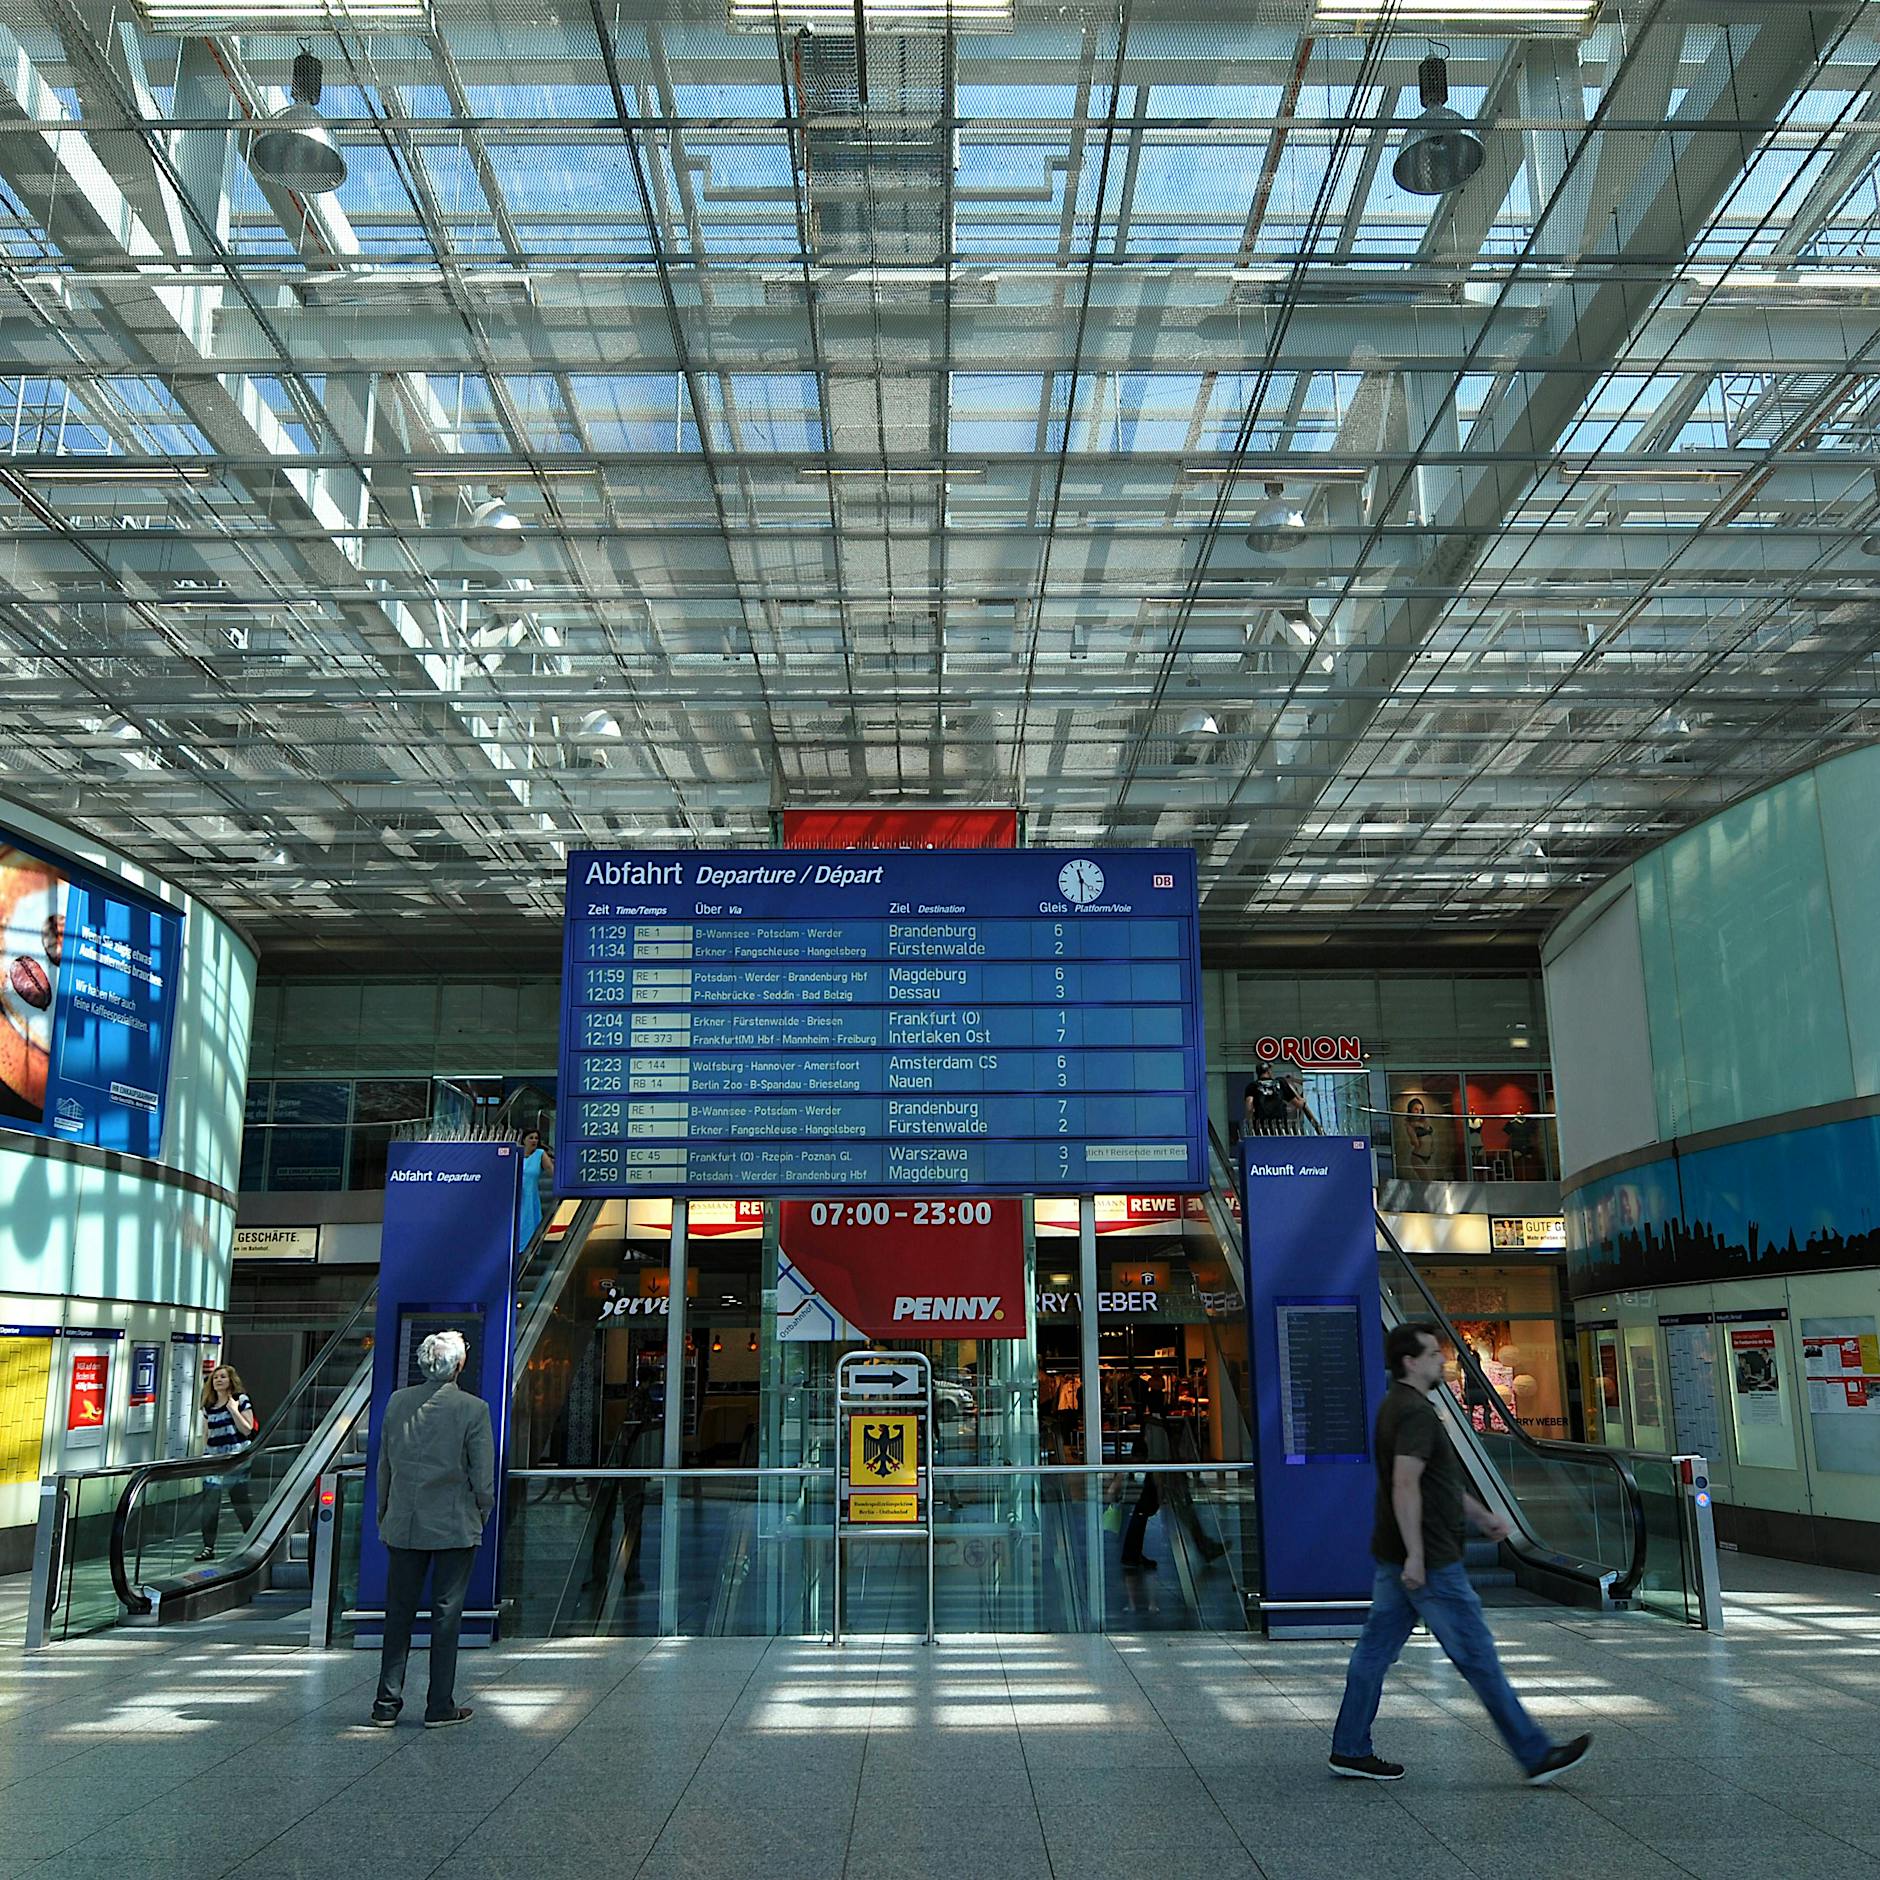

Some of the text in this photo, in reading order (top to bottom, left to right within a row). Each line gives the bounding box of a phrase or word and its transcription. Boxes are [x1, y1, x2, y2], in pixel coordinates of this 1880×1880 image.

[586, 861, 883, 887] Abfahrt Departure Départ
[1154, 876, 1172, 887] DB
[588, 904, 667, 915] Zeit Time/Temps
[696, 902, 742, 914] Über Via
[889, 902, 965, 913] Ziel Destination
[1039, 902, 1131, 913] Gleis Platform/Voie
[589, 927, 626, 939] 11:29
[638, 928, 660, 937] RE 1
[696, 929, 842, 939] B-Wannsee Potsdam Werder
[889, 924, 976, 939] Brandenburg
[1054, 924, 1063, 936] 6
[588, 944, 625, 957] 11:34
[638, 946, 660, 955] RE 1
[695, 947, 866, 958] Erkner Fangschleuse Hangelsberg
[889, 941, 985, 955] Fürstenwalde
[1055, 942, 1063, 954] 2
[587, 970, 624, 983] 11:59
[636, 972, 659, 981] RE 1
[694, 972, 867, 983] Potsdam Werder Brandenburg Hbf
[889, 969, 966, 984] Magdeburg
[1055, 968, 1064, 981] 6
[587, 988, 624, 1001] 12:03
[636, 990, 658, 999] RE 7
[694, 990, 852, 1001] P-Rehbrücke Seddin Bad Belzig
[889, 987, 940, 999] Dessau
[1056, 986, 1064, 998] 3
[586, 1014, 623, 1027] 12:04
[636, 1016, 657, 1025] RE 1
[694, 1016, 843, 1026] Erkner Fürstenwalde Briesen
[889, 1011, 980, 1025] Frankfurt (O)
[1060, 1012, 1065, 1024] 1
[585, 1032, 622, 1045] 12:19
[634, 1034, 672, 1043] ICE 373
[693, 1035, 876, 1046] Frankfurt(M) Hbf Mannheim Freiburg
[889, 1030, 990, 1043] Interlaken Ost
[1057, 1030, 1065, 1042] 7
[1256, 1036, 1363, 1068] ORION
[584, 1059, 622, 1071] 12:23
[633, 1060, 665, 1069] IC 144
[693, 1061, 859, 1072] Wolfsburg Hannover Amersfoort
[889, 1056, 997, 1069] Amsterdam CS
[1057, 1056, 1066, 1068] 6
[583, 1077, 621, 1090] 12:26
[633, 1079, 662, 1088] RB 14
[692, 1079, 860, 1090] Berlin Zoo B-Spandau Brieselang
[889, 1075, 932, 1088] Nauen
[1058, 1075, 1066, 1086] 3
[582, 1103, 620, 1117] 12:29
[632, 1105, 654, 1114] RE 1
[691, 1106, 841, 1116] B-Wannsee Potsdam Werder
[889, 1101, 978, 1117] Brandenburg
[1059, 1101, 1067, 1113] 7
[581, 1122, 619, 1136] 12:34
[632, 1124, 654, 1133] RE 1
[691, 1124, 866, 1135] Erkner Fangschleuse Hangelsberg
[889, 1119, 987, 1133] Fürstenwalde
[1059, 1120, 1068, 1132] 2
[581, 1149, 618, 1163] 12:50
[631, 1151, 660, 1161] EC 45
[690, 1152, 736, 1162] Frankfurt
[762, 1152, 793, 1163] Rzepin
[802, 1152, 836, 1161] Poznan
[890, 1147, 967, 1160] Warszawa
[1060, 1147, 1068, 1159] 3
[579, 1168, 618, 1181] 12:59
[630, 1170, 653, 1179] RE 1
[690, 1170, 867, 1181] Potsdam Werder Brandenburg Hbf
[889, 1166, 968, 1182] Magdeburg
[1060, 1165, 1069, 1177] 7
[1251, 1165, 1328, 1175] Ankunft Arrival
[390, 1171, 481, 1182] Abfahrt Departure
[1131, 1198, 1176, 1212] REWE
[811, 1202, 991, 1225] 07:00 23:00
[1526, 1222, 1551, 1231] GUTE
[238, 1230, 300, 1242] GESCHÄFTE.
[780, 1304, 814, 1338] Ostbahnhof
[1536, 1416, 1569, 1426] WEBER
